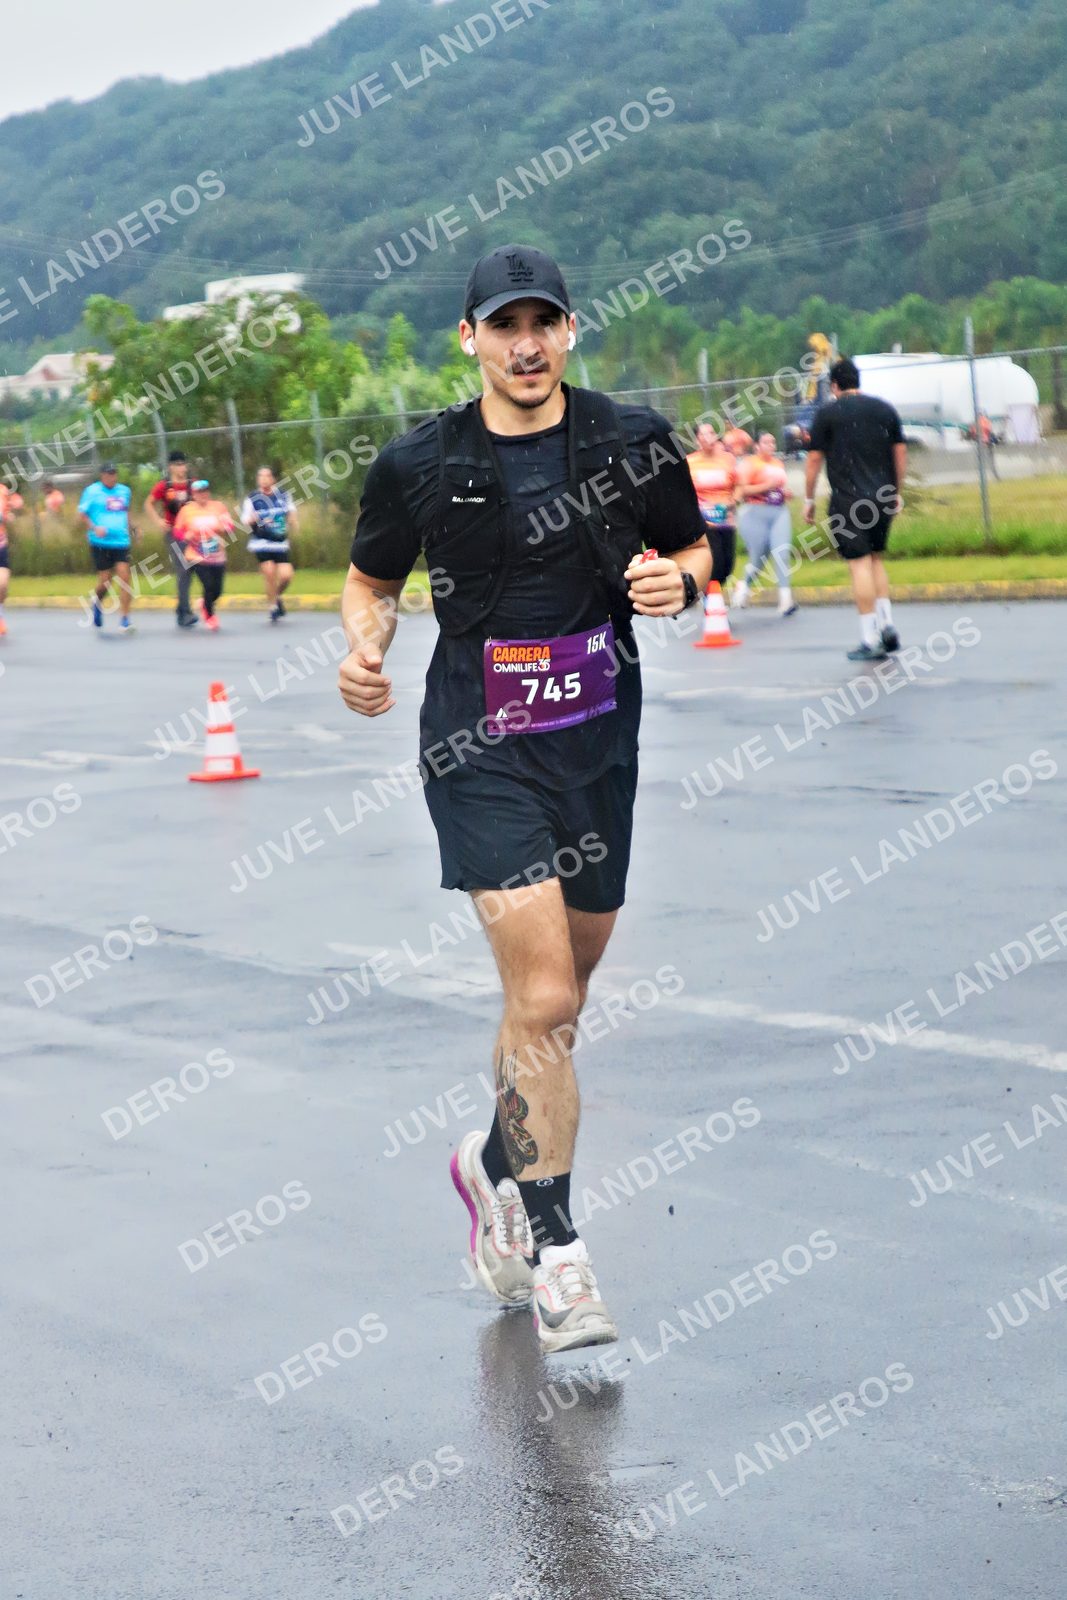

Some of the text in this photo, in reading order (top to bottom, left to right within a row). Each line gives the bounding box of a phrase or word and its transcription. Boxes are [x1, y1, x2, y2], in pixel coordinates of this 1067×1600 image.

[492, 645, 551, 663] CARRERA
[586, 631, 607, 655] 15K
[521, 672, 582, 705] 745
